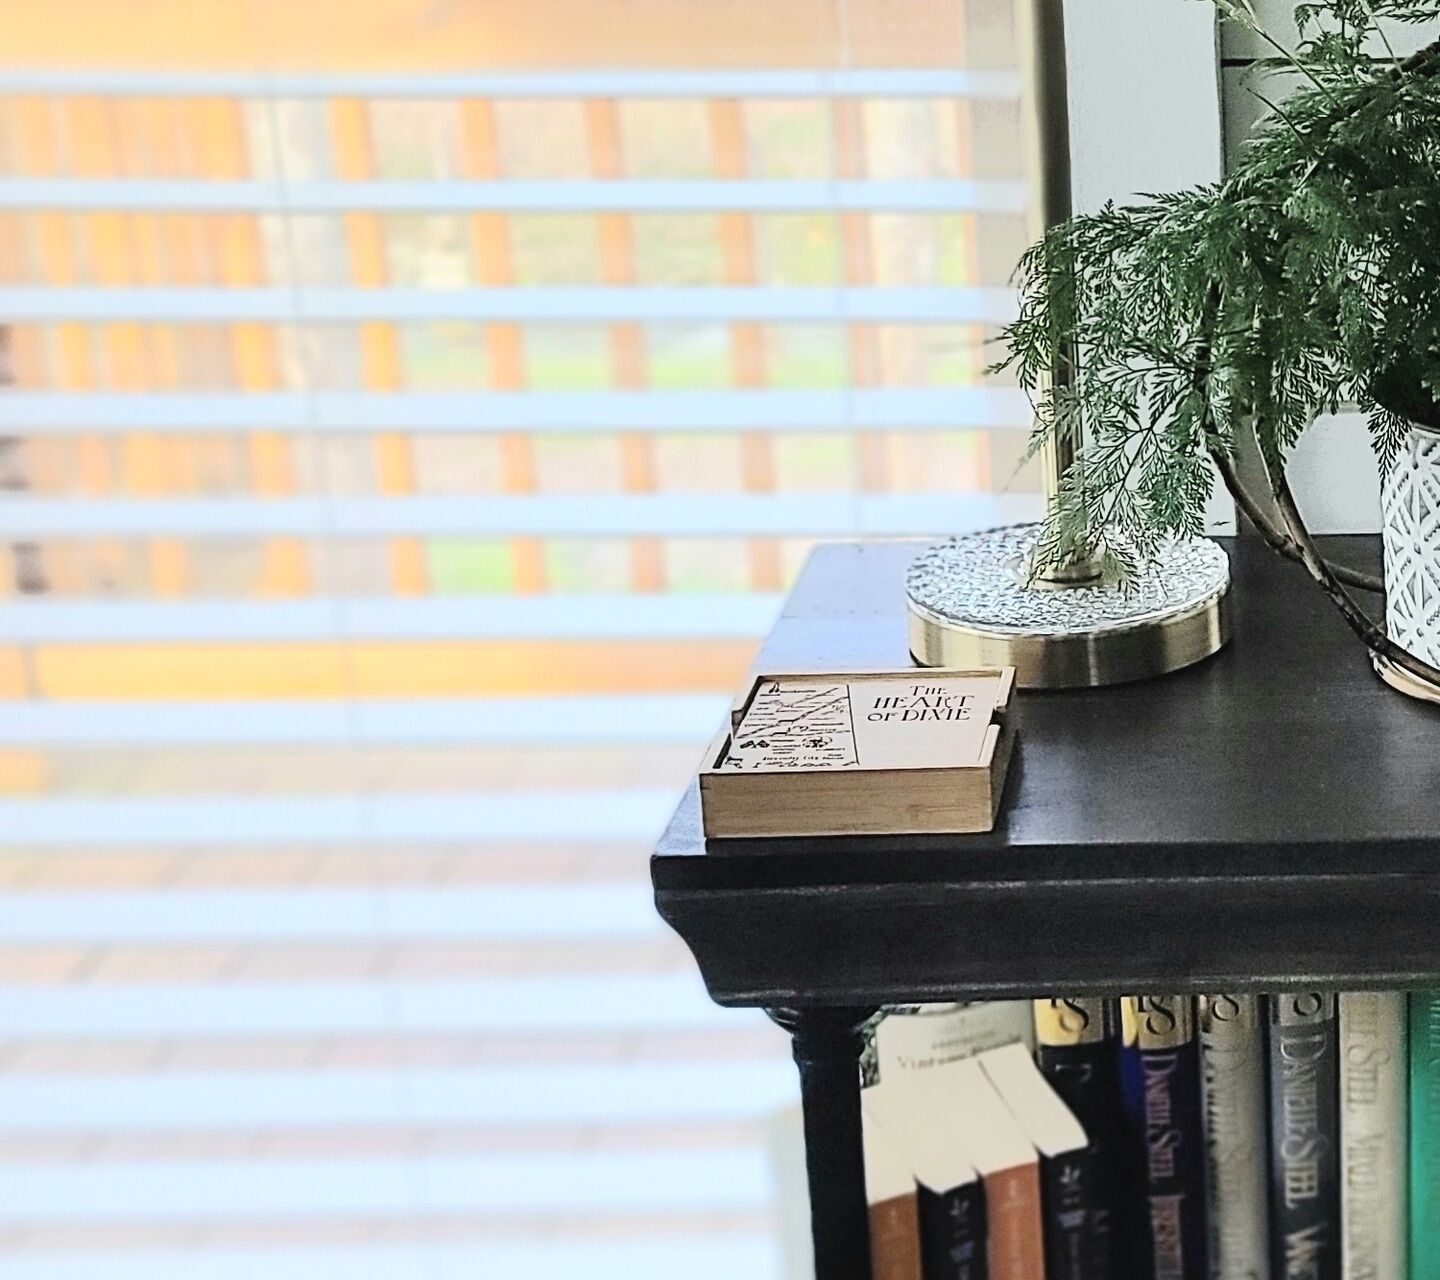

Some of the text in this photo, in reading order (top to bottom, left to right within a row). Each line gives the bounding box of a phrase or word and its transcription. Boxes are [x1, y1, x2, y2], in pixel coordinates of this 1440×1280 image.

[873, 695, 975, 709] HEART
[901, 708, 972, 721] DIXIE
[1142, 1054, 1179, 1126] DANIELLE
[1279, 1034, 1328, 1133] DANIELLE
[1148, 1125, 1183, 1182] STEEL
[1280, 1134, 1330, 1208] STEEL
